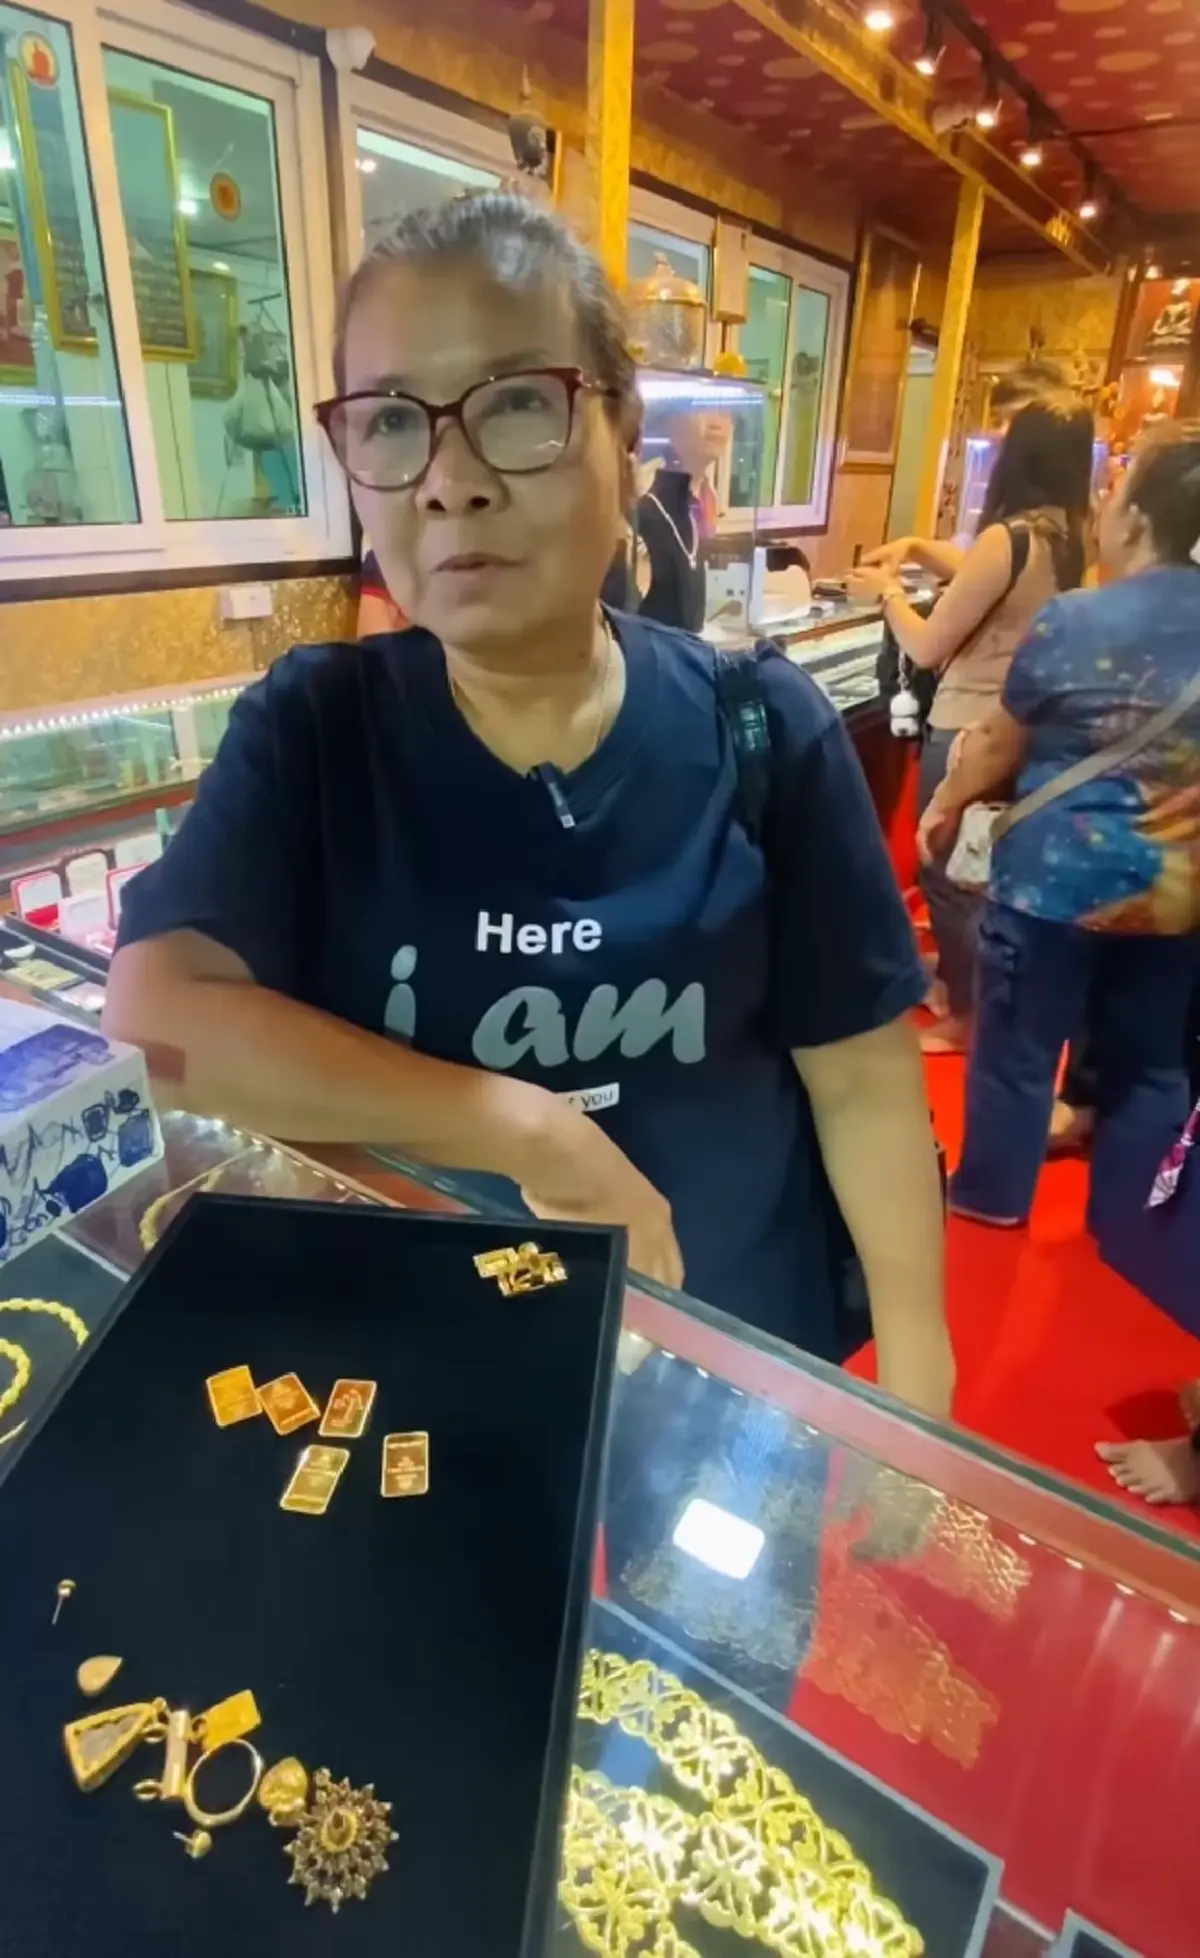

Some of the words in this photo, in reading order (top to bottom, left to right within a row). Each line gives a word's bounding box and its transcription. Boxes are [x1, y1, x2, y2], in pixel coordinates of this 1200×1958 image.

[476, 911, 603, 953] Here
[384, 944, 418, 1038] i
[472, 978, 706, 1070] am
[580, 1090, 615, 1109] you
